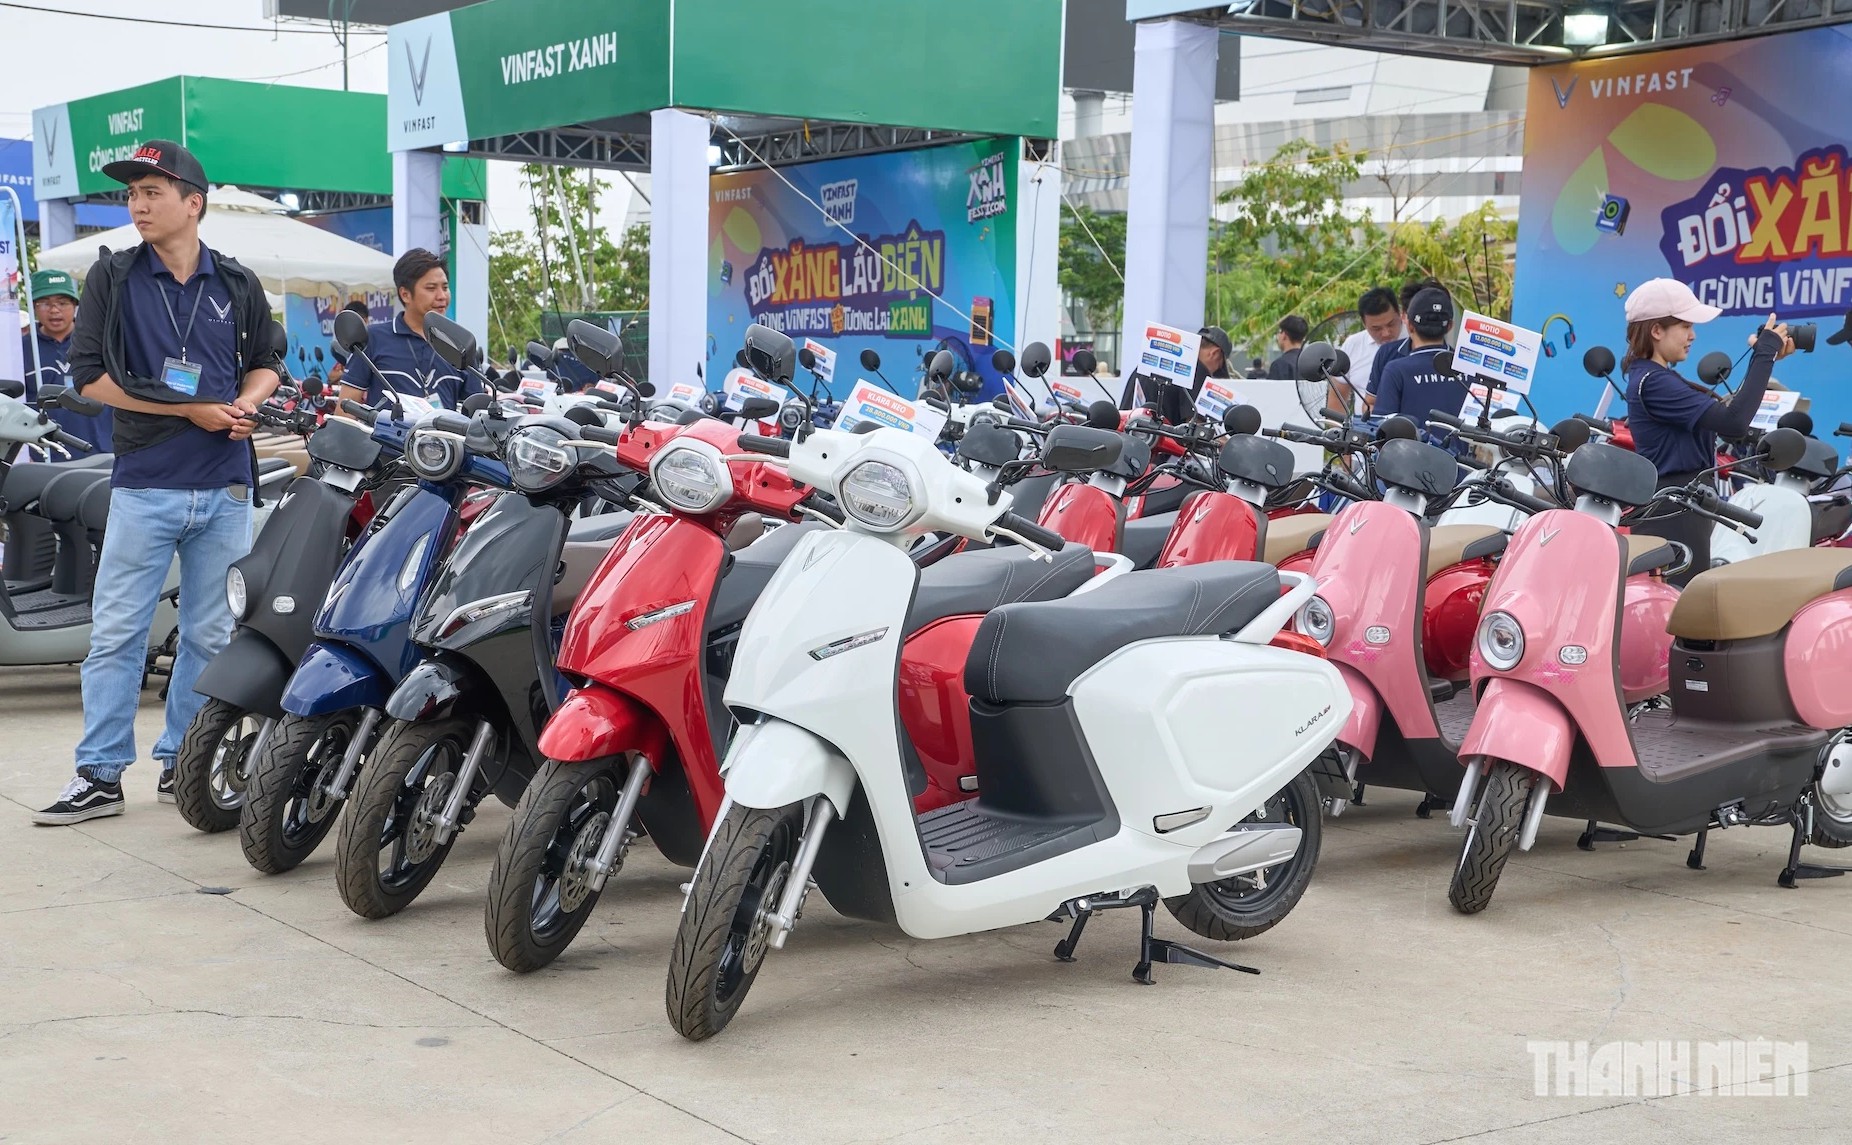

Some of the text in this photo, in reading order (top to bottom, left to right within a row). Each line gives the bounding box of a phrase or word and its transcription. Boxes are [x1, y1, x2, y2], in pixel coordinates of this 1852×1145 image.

[501, 31, 617, 86] VINFAST XANH
[1590, 67, 1694, 99] VINFAST
[108, 108, 144, 136] VINFAST
[403, 116, 435, 133] VINFAST
[0, 173, 33, 186] FAST
[822, 182, 856, 202] VINFAST
[715, 187, 751, 203] VINFAST
[826, 203, 852, 223] XANH
[1739, 159, 1852, 259] XĂ
[771, 243, 841, 303] XĂNG
[1699, 267, 1852, 310] CÙNG ViNF
[890, 305, 927, 331] XANH
[1480, 323, 1500, 335] MOTIO
[867, 392, 907, 414] KLARA NEO
[1295, 711, 1323, 737] KLARA
